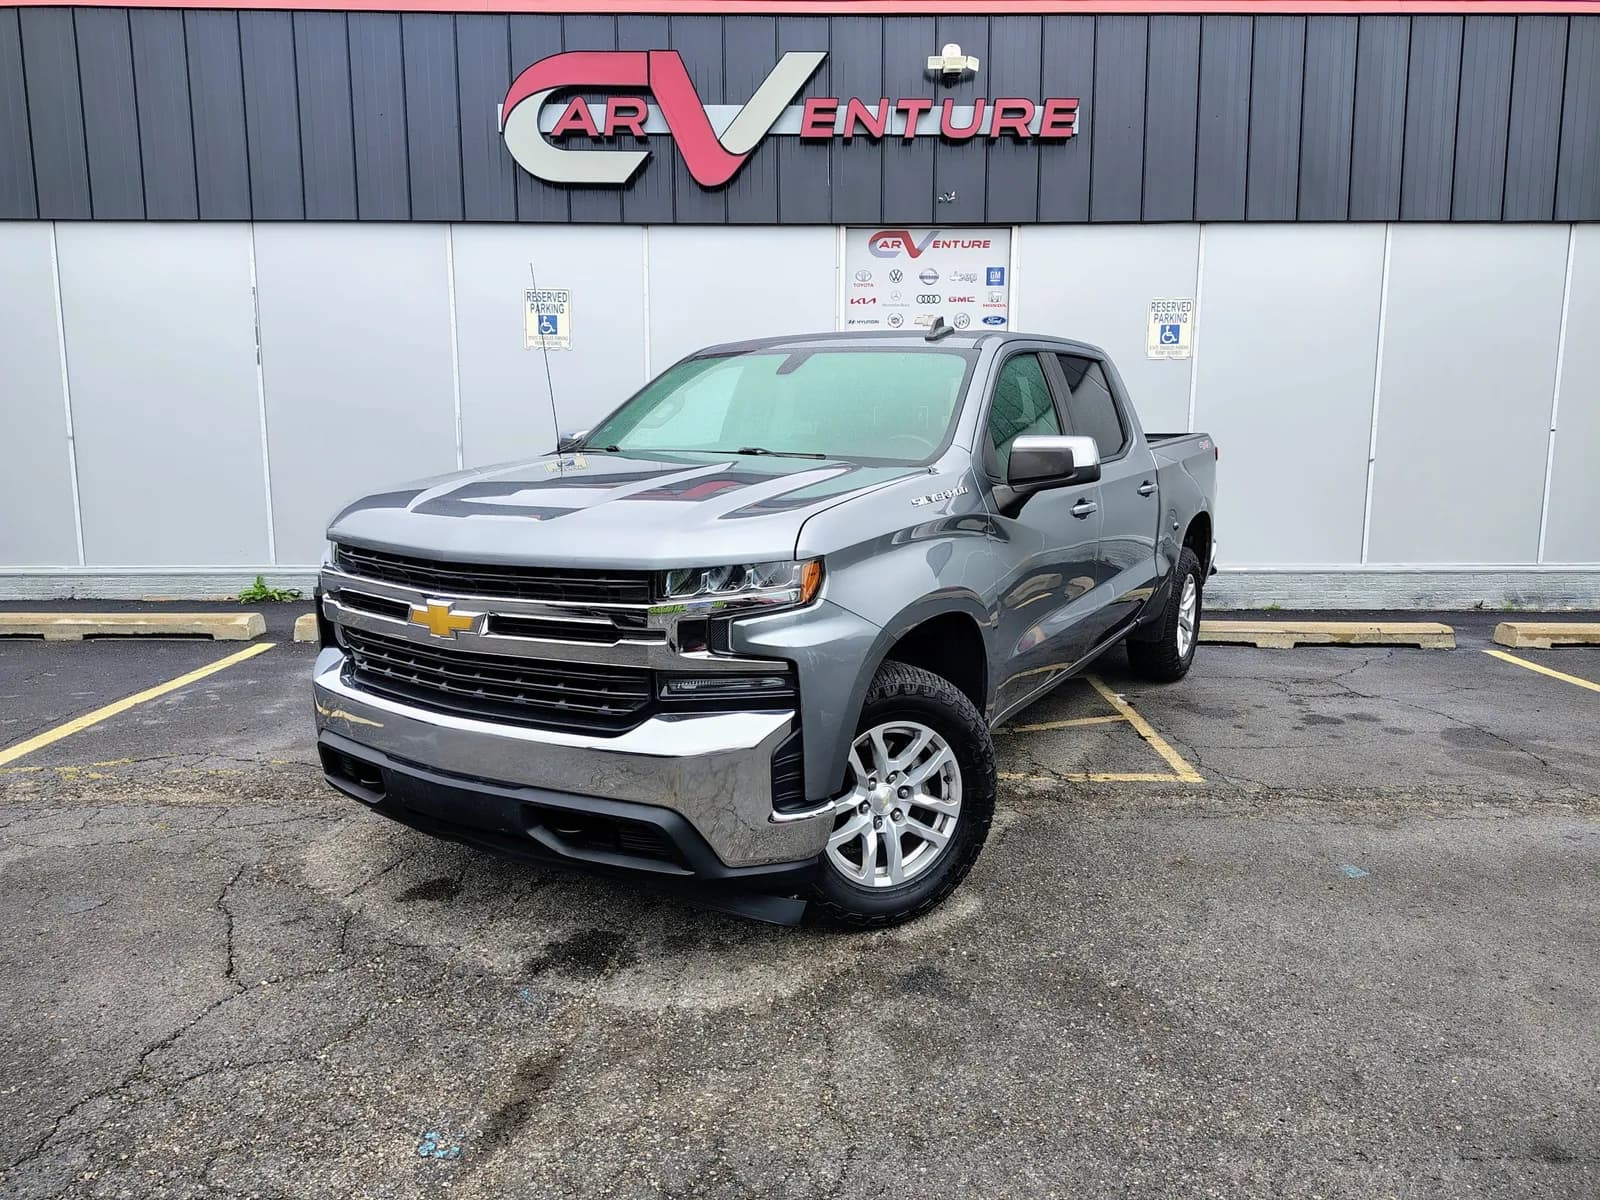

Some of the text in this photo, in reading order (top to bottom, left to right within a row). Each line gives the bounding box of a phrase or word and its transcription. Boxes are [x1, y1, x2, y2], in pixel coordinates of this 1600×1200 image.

[526, 291, 568, 302] RESERVED
[530, 303, 565, 314] PARKING
[1151, 301, 1192, 312] RESERVED
[1153, 312, 1188, 323] PARKING
